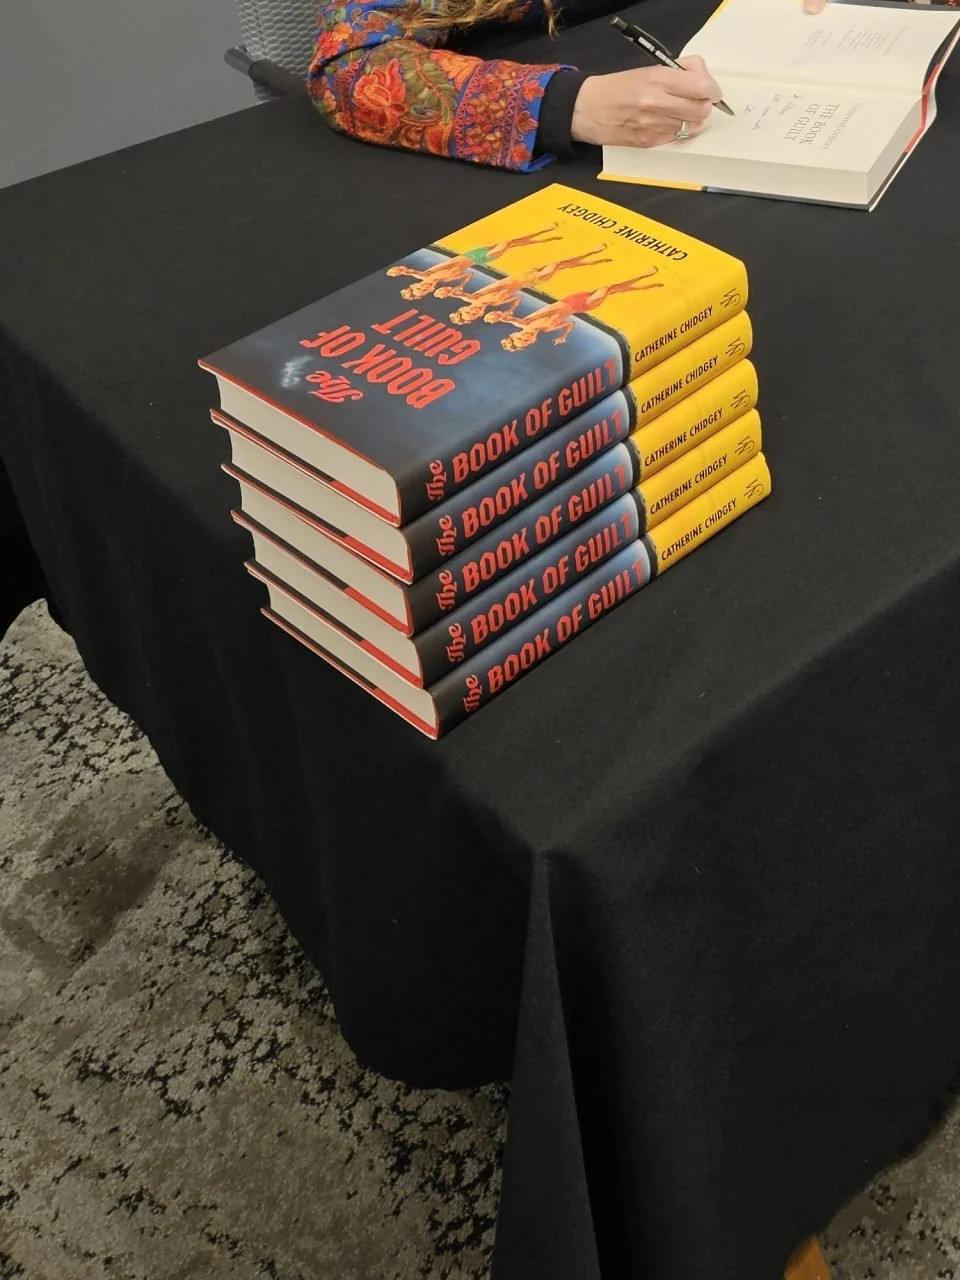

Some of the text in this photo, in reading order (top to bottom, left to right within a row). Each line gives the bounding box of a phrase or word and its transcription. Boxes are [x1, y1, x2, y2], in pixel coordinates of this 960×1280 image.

[783, 116, 810, 141] GUILT
[799, 103, 840, 145] THE BOOK
[805, 103, 820, 116] OF
[556, 203, 688, 261] CATHERINE CHIDGEY
[370, 308, 481, 365] GUILT
[634, 305, 713, 363] CATHERINE CHIDGEY
[299, 324, 456, 409] BOOK OF
[305, 370, 364, 403] The
[641, 355, 718, 414] CATHERINE CHIDGEY
[425, 357, 616, 501] The BOOK OF GUILT
[644, 408, 723, 467] CATHERINE CHIDGEY
[436, 410, 624, 557] The BOOK OF GUILT
[650, 454, 727, 515] CATHERINE CHIDGEY
[435, 463, 626, 611] The BOOK OF GUILT
[661, 498, 737, 561] CATHERINE CHIDGEY
[446, 513, 632, 663] The BOOK OF GUILT
[463, 559, 644, 713] The BOOK OF GUILT
